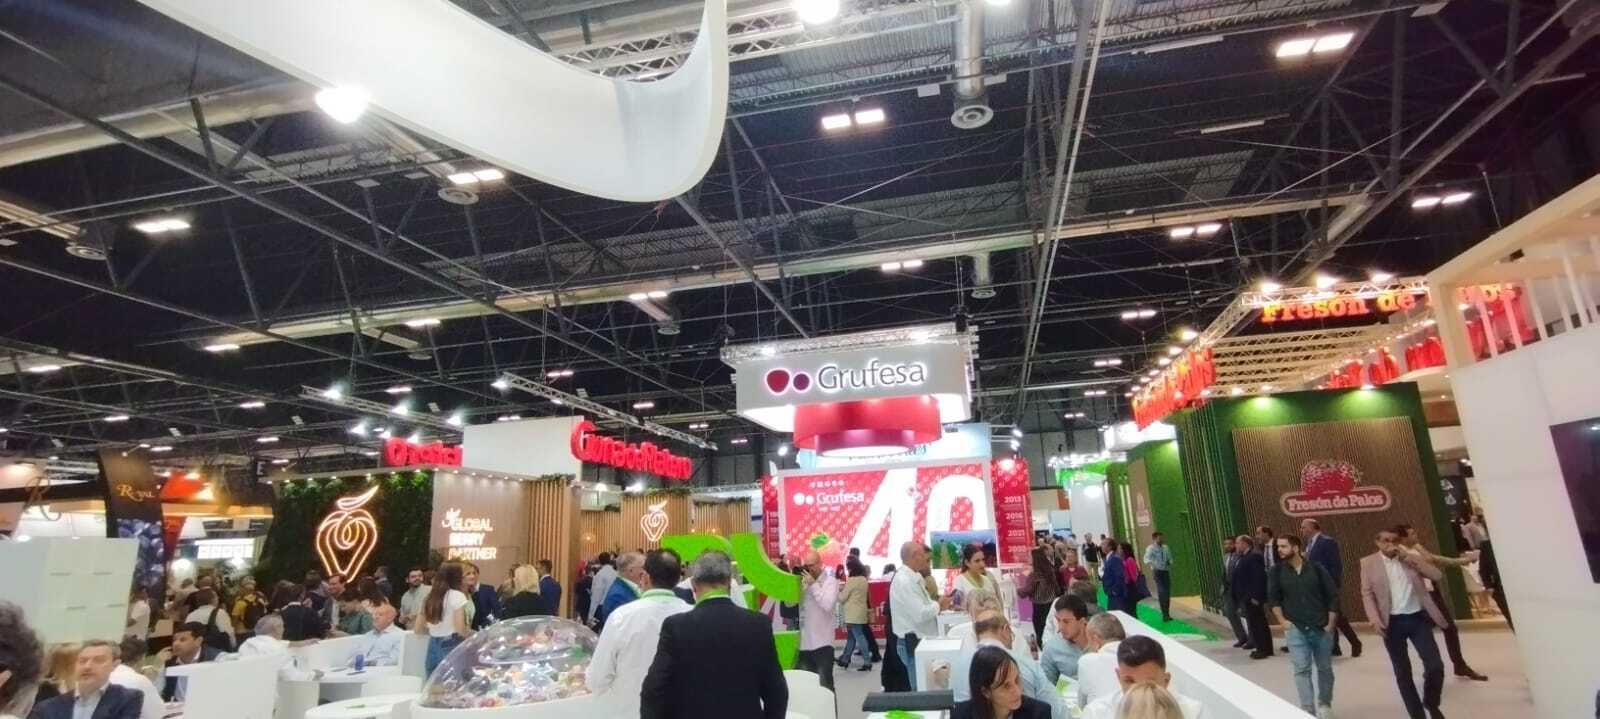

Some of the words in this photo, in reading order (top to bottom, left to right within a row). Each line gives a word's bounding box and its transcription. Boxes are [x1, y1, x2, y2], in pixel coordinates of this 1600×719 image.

[1377, 289, 1416, 312] de
[819, 361, 926, 390] Grufesa
[816, 488, 865, 504] Grufesa
[1333, 495, 1348, 508] de
[1348, 493, 1383, 507] Palos
[451, 517, 493, 532] GLOBAL
[449, 532, 485, 546] BERRY
